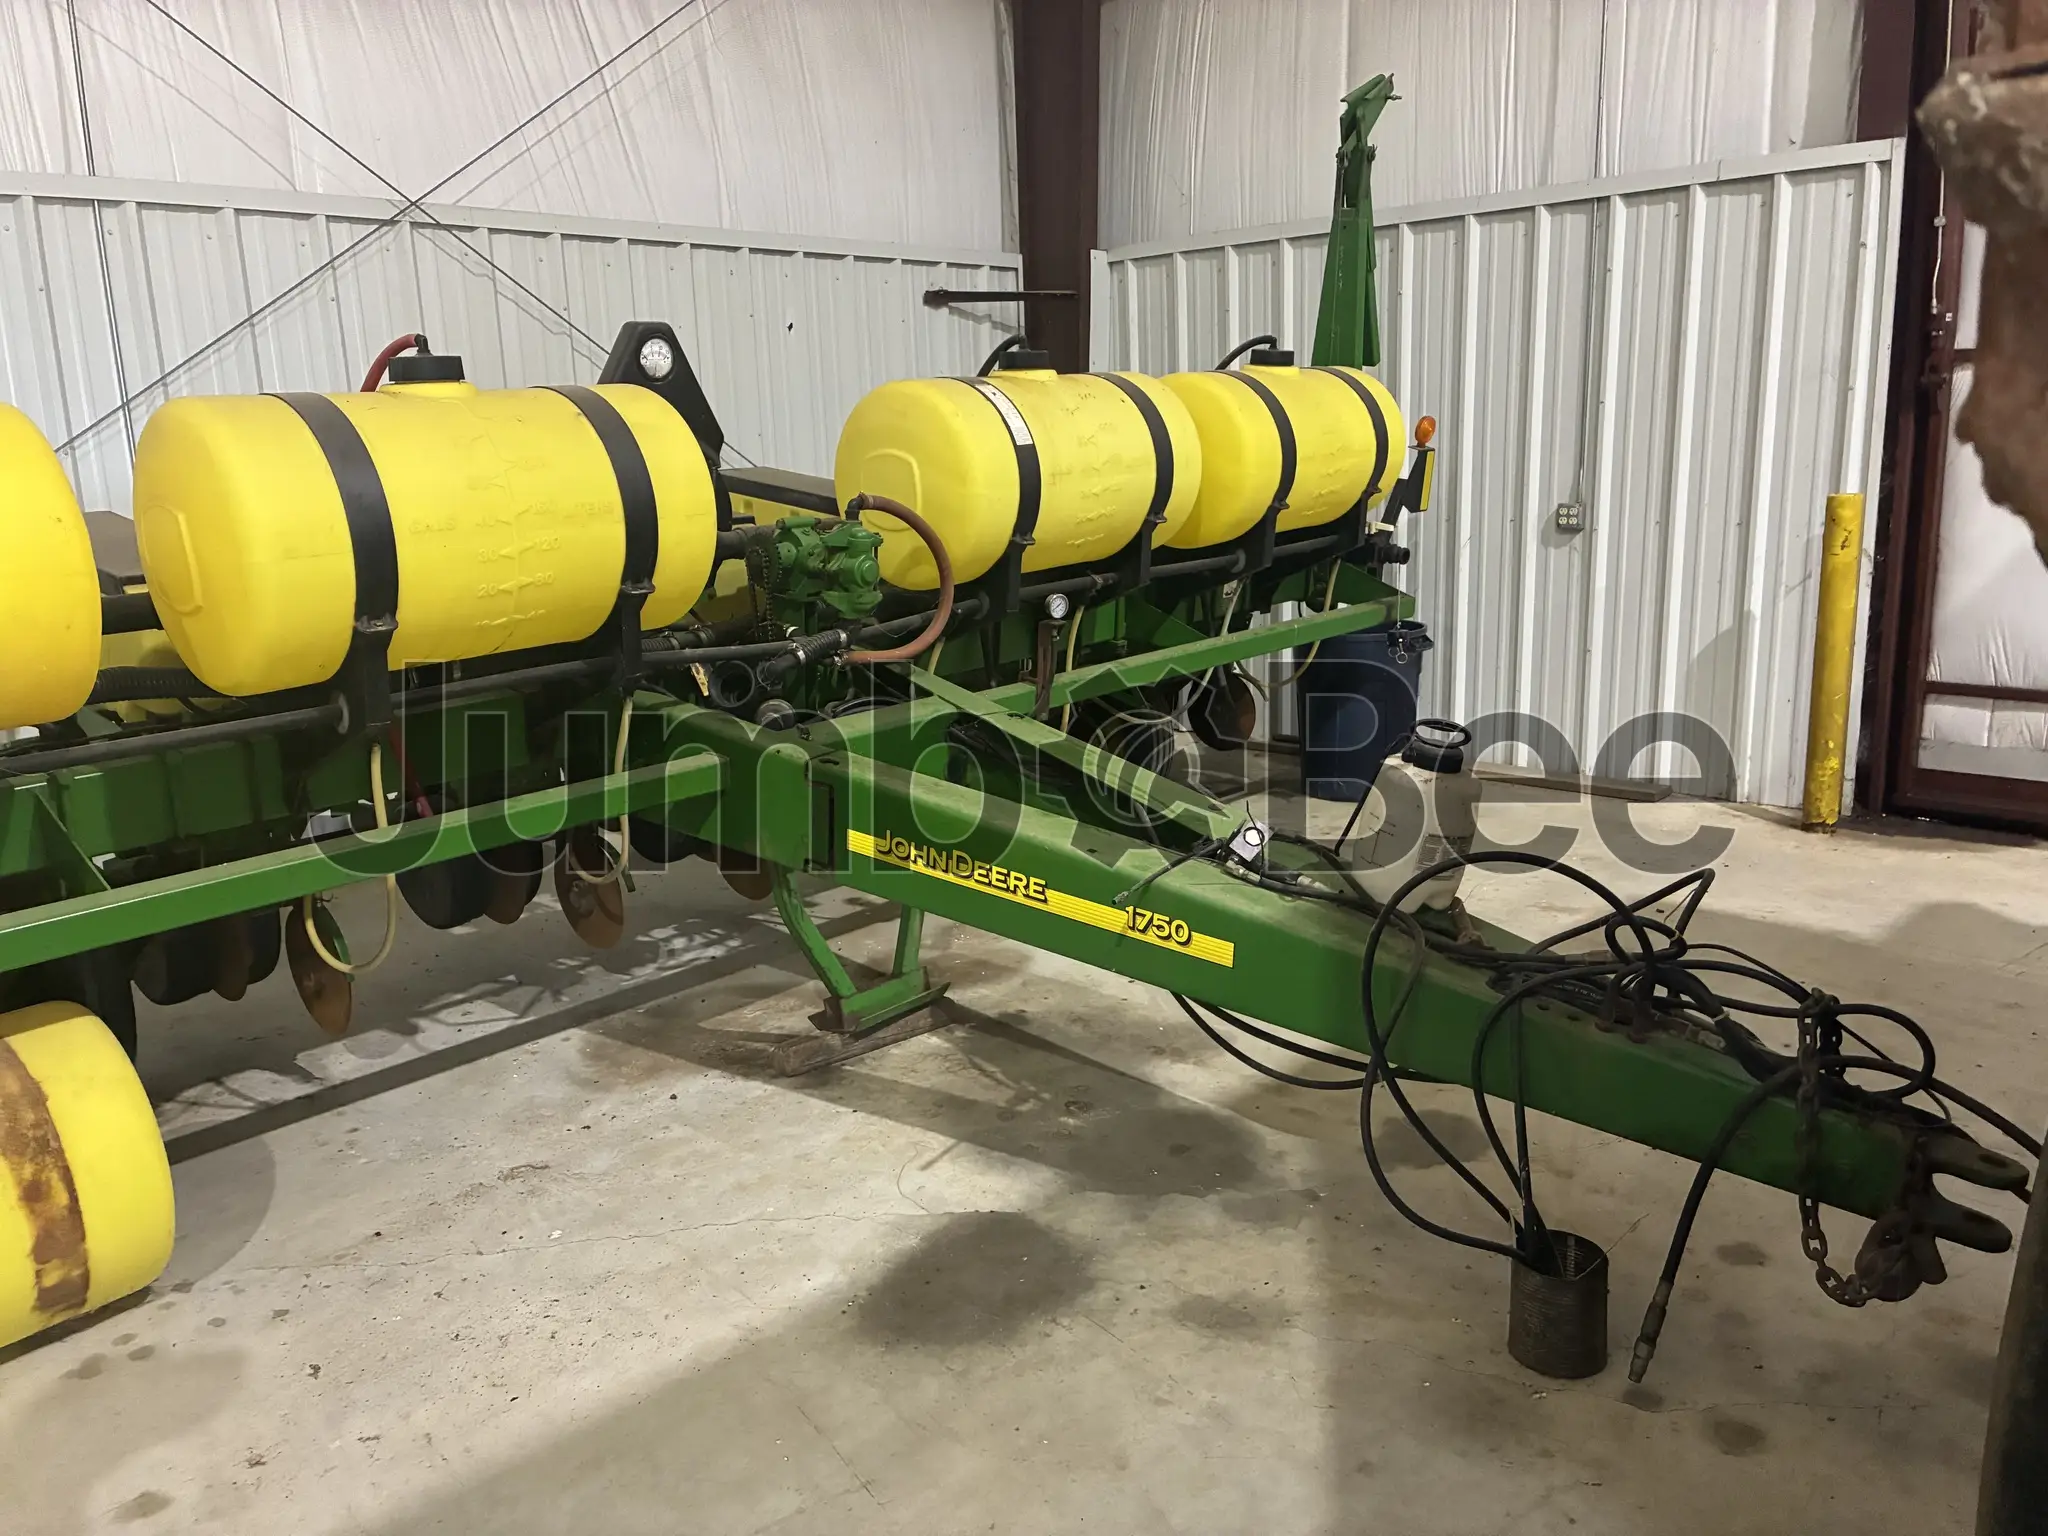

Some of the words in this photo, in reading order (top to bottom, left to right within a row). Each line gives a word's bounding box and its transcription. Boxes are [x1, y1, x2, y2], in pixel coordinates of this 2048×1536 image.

[477, 583, 499, 599] 20
[874, 829, 951, 872] JOHN
[950, 849, 1047, 903] DEERE
[1124, 905, 1192, 947] 1750
